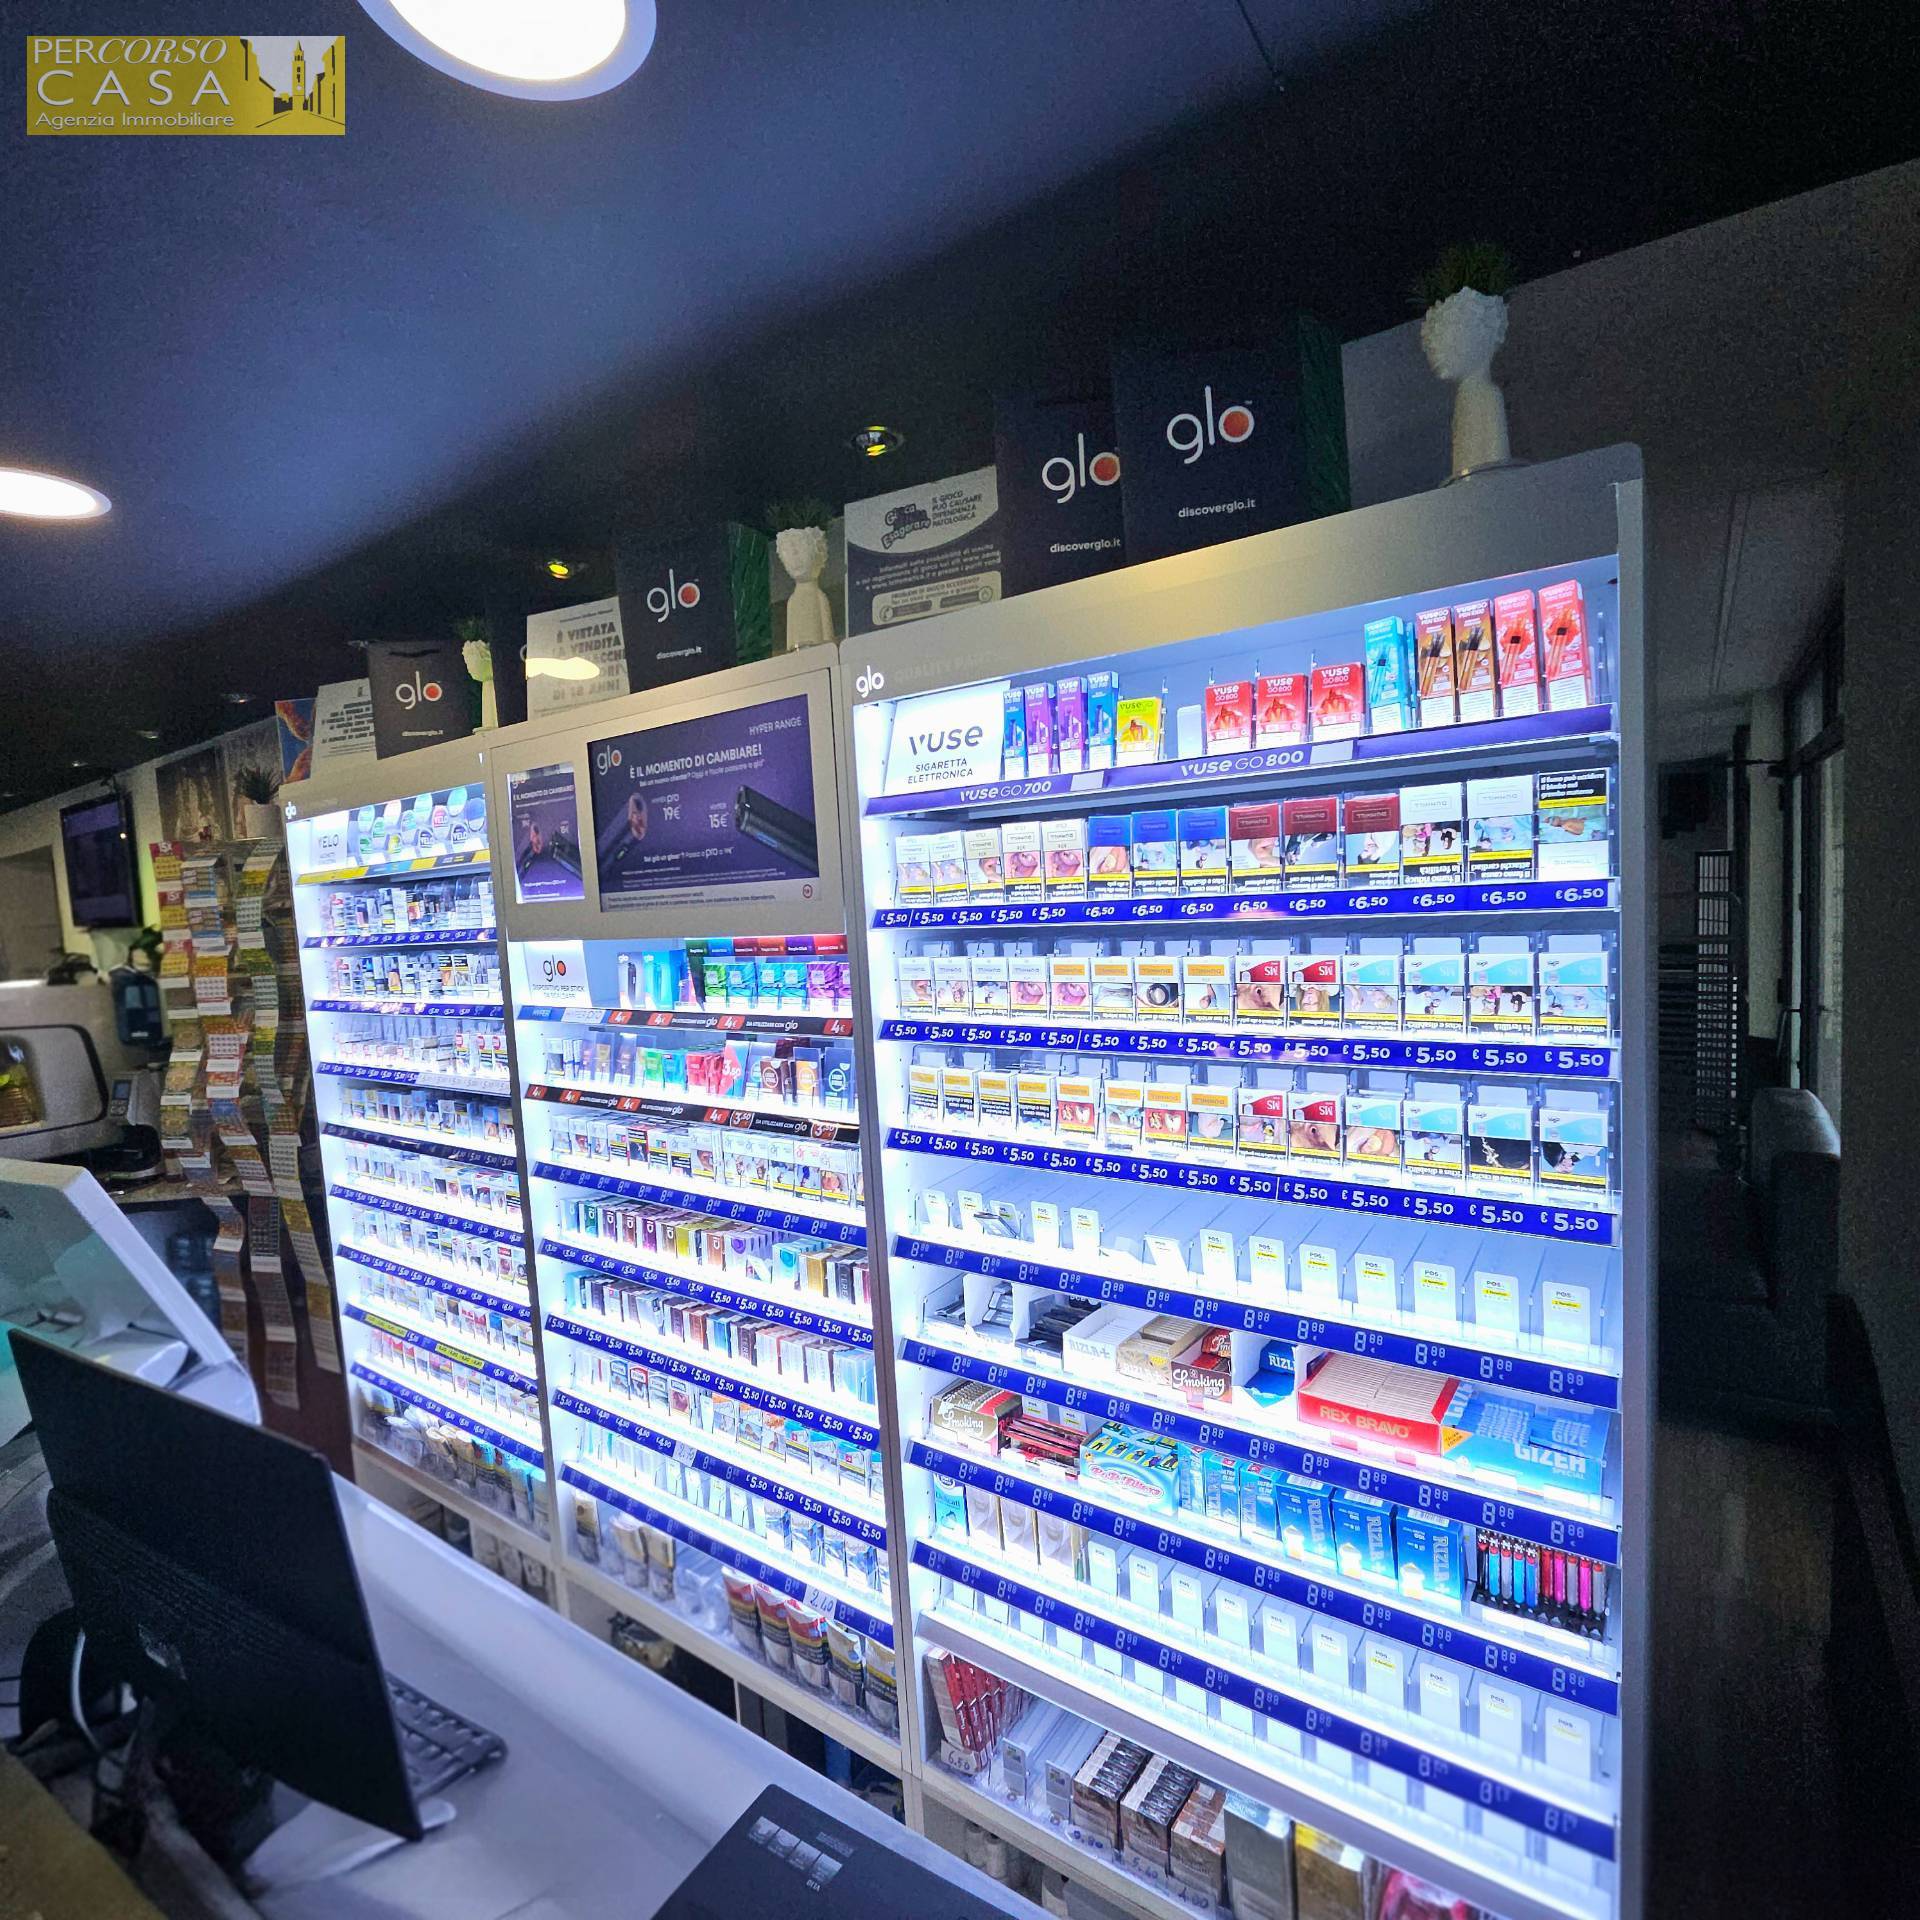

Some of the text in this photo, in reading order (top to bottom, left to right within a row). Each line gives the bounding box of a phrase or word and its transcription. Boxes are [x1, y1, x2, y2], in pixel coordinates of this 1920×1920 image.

[1166, 385, 1255, 464] glo
[1041, 432, 1120, 504] glo
[1178, 498, 1256, 518] discoverglo.it
[1050, 538, 1120, 553] discoverglo.it
[647, 569, 700, 623] glo
[567, 622, 616, 641] VIETATA
[571, 635, 621, 653] VENDITA
[396, 671, 443, 710] glo
[856, 665, 884, 698] glo
[749, 717, 802, 735] HYPER RANGE
[597, 745, 622, 776] glo
[637, 764, 645, 777] IL
[645, 757, 693, 776] MOMENTO
[694, 755, 705, 766] DI
[707, 743, 762, 765] CAMBIARE!
[915, 757, 968, 772] SIGARETTA
[1235, 756, 1264, 770] GO
[1266, 750, 1304, 767] 800
[907, 769, 973, 785] ELETTRONICA
[1000, 785, 1021, 798] GO
[1023, 780, 1052, 795] 700
[543, 955, 566, 982] glo
[784, 1020, 798, 1031] glo
[794, 1122, 807, 1132] glo
[1173, 1368, 1225, 1395] Smoking
[942, 1413, 984, 1433] Smoking
[1320, 1405, 1408, 1438] REX BRAVO
[1514, 1444, 1586, 1474] GIZEH
